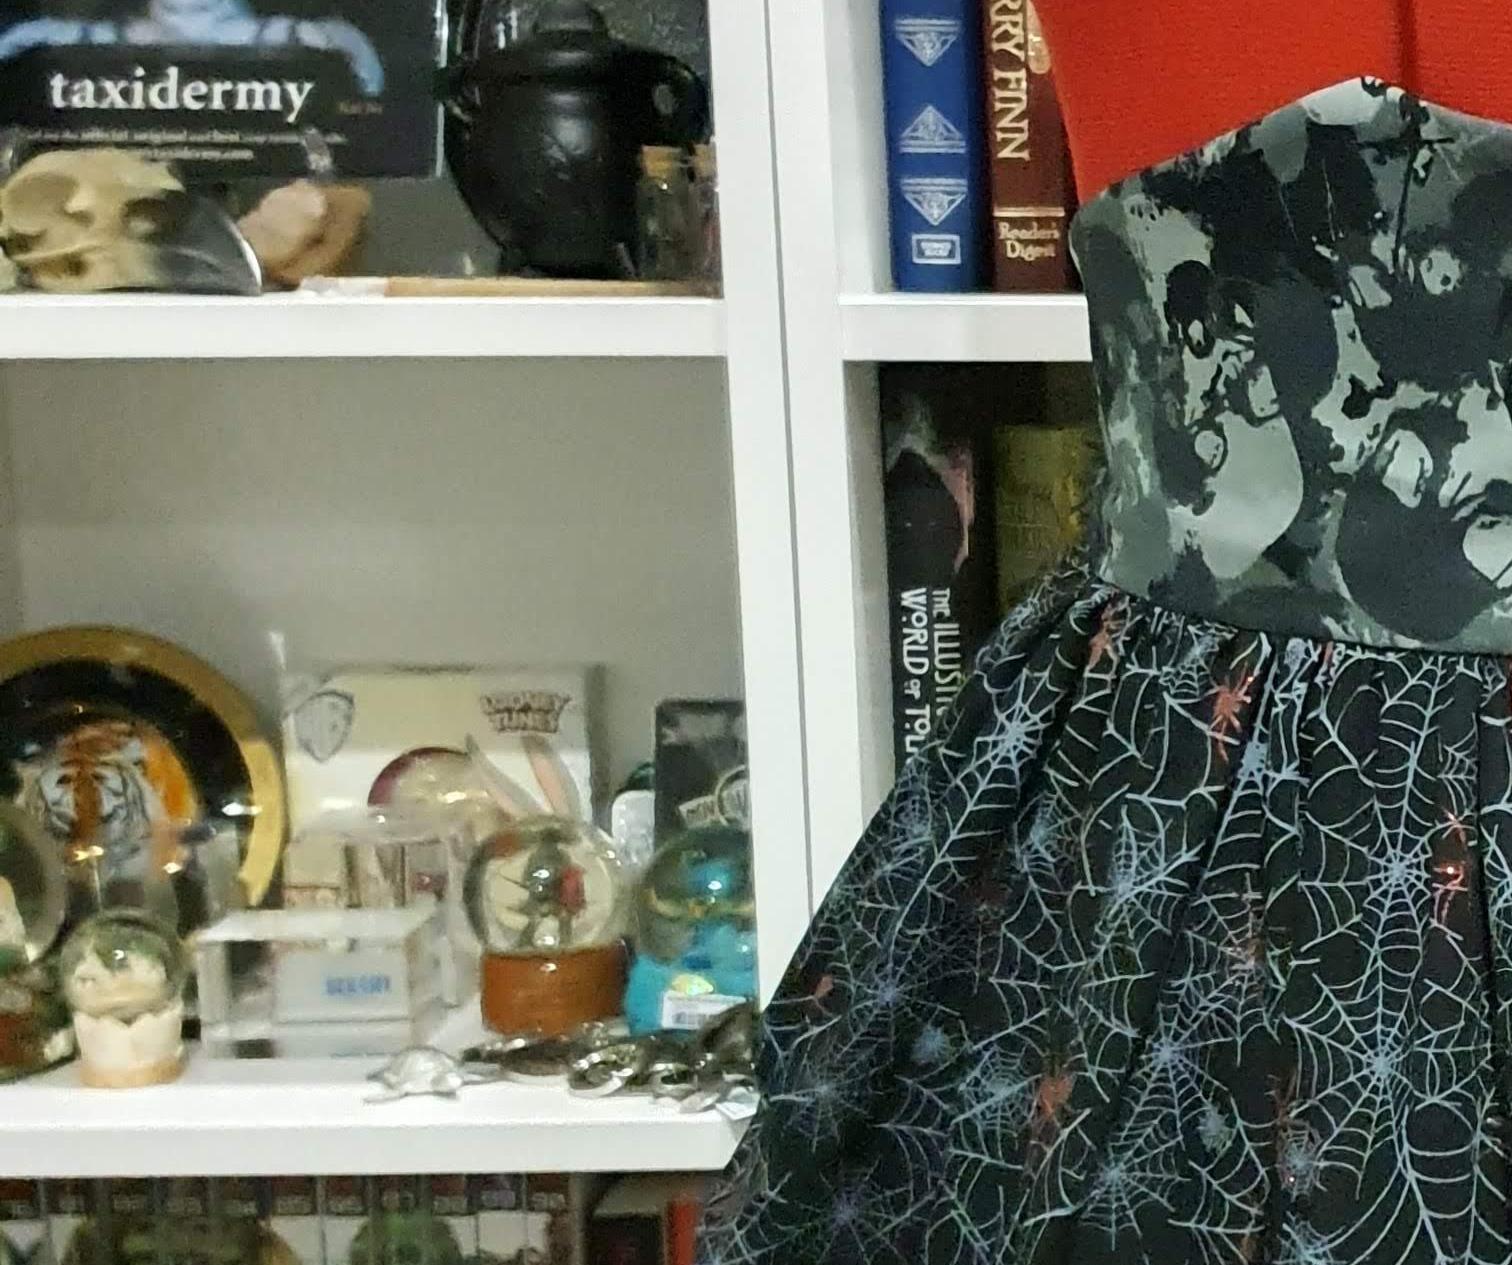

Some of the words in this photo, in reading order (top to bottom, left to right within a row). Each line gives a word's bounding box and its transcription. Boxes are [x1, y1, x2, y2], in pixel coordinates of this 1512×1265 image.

[49, 66, 314, 123] taxidermy
[993, 68, 1029, 161] FINN
[1006, 240, 1056, 261] Digest
[901, 588, 929, 675] WORLD
